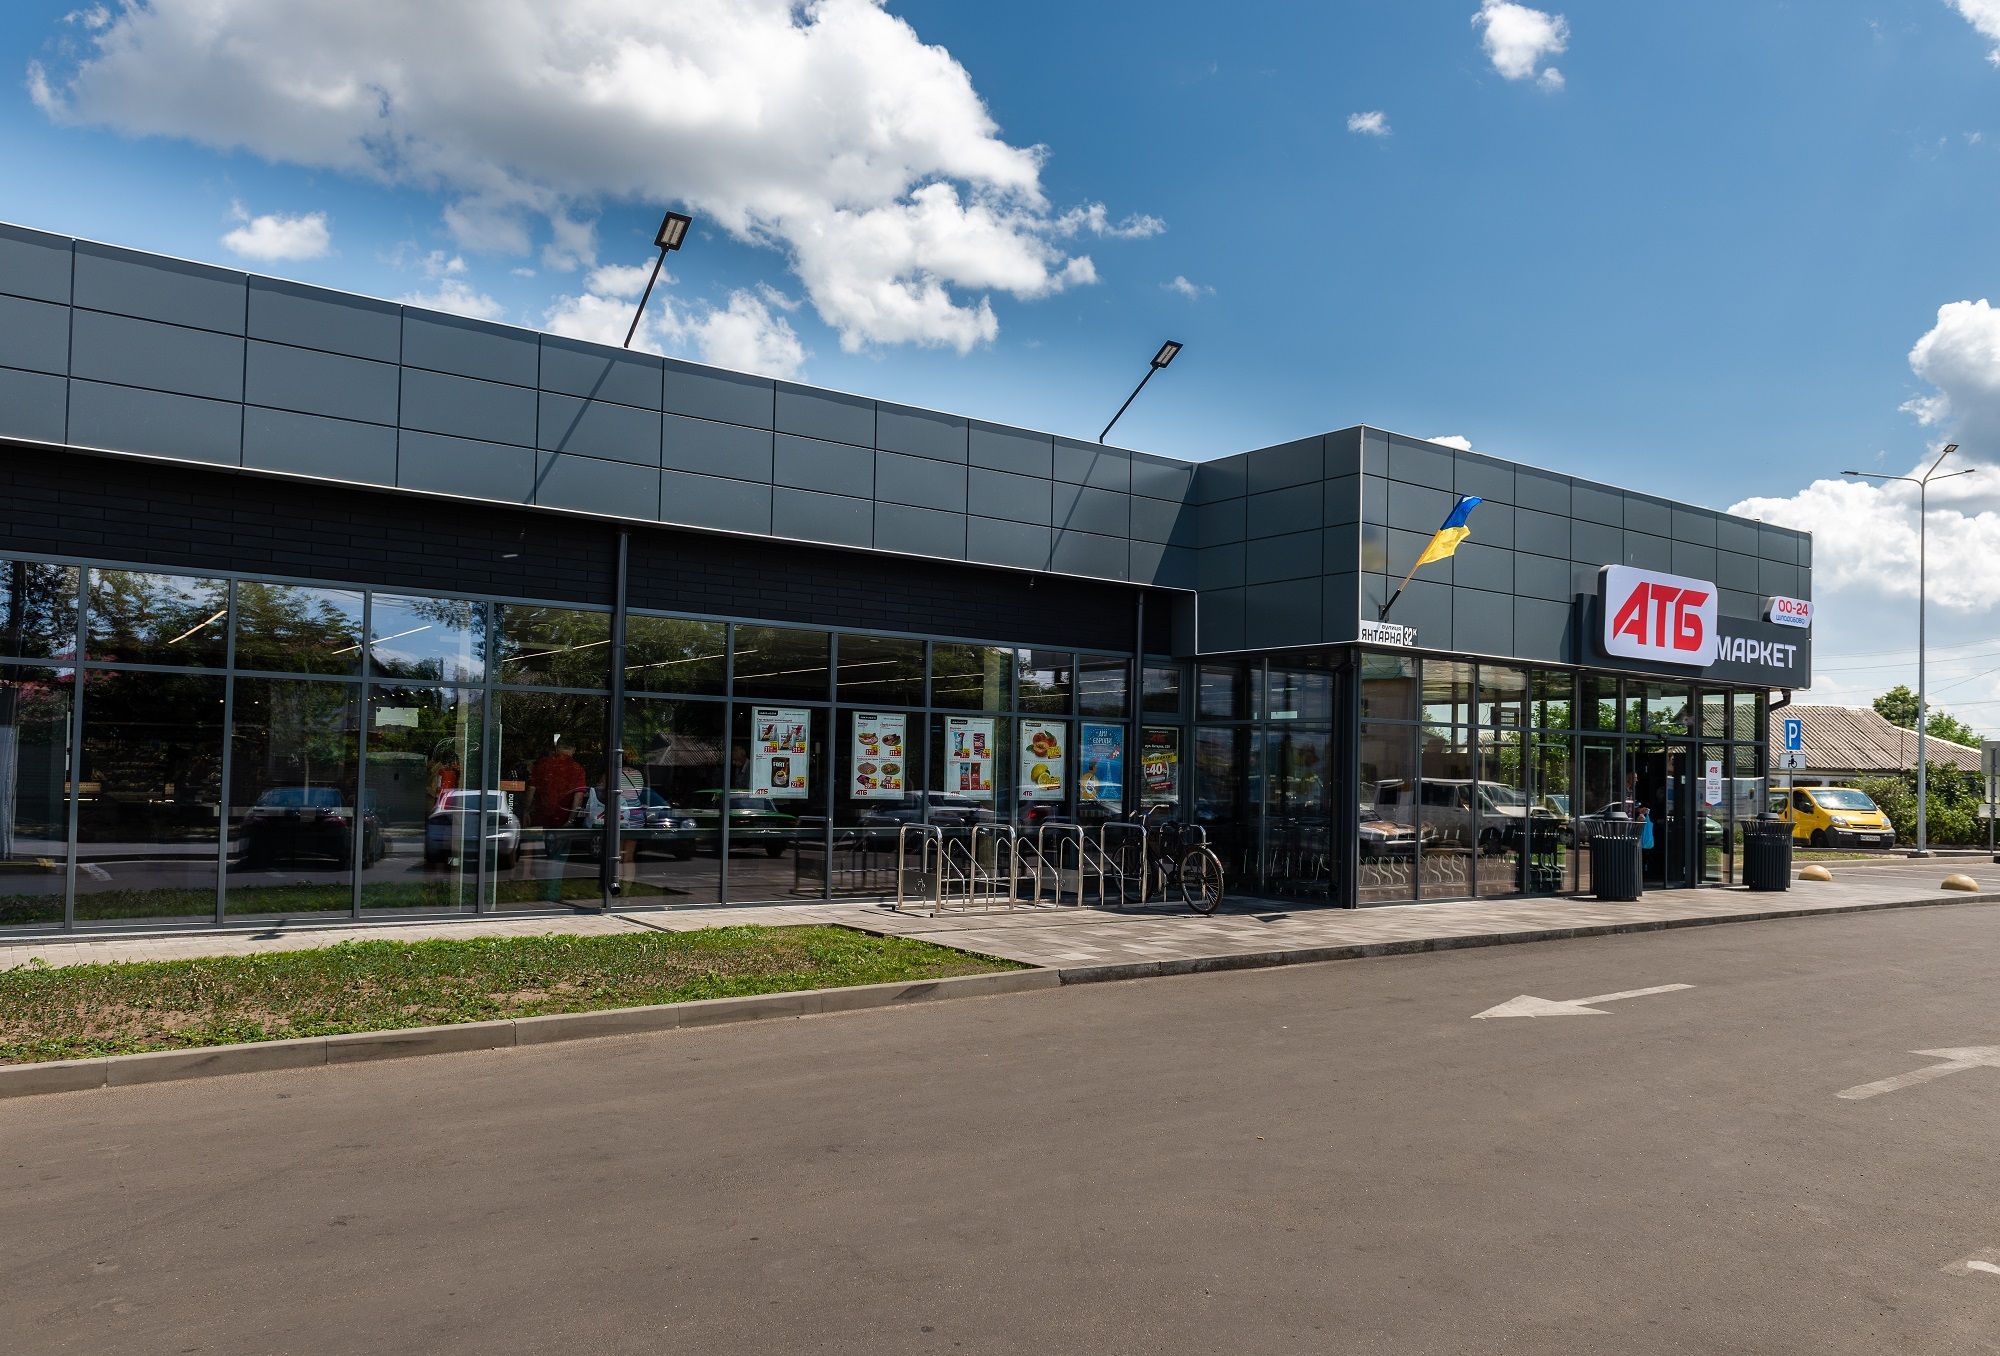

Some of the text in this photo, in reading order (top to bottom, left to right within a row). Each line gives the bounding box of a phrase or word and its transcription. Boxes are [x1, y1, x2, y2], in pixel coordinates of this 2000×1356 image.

[1612, 581, 1709, 652] АТБ
[1778, 599, 1809, 616] 00-24
[1361, 628, 1402, 645] ЯНТАРНА
[1715, 634, 1797, 669] МАРКЕТ
